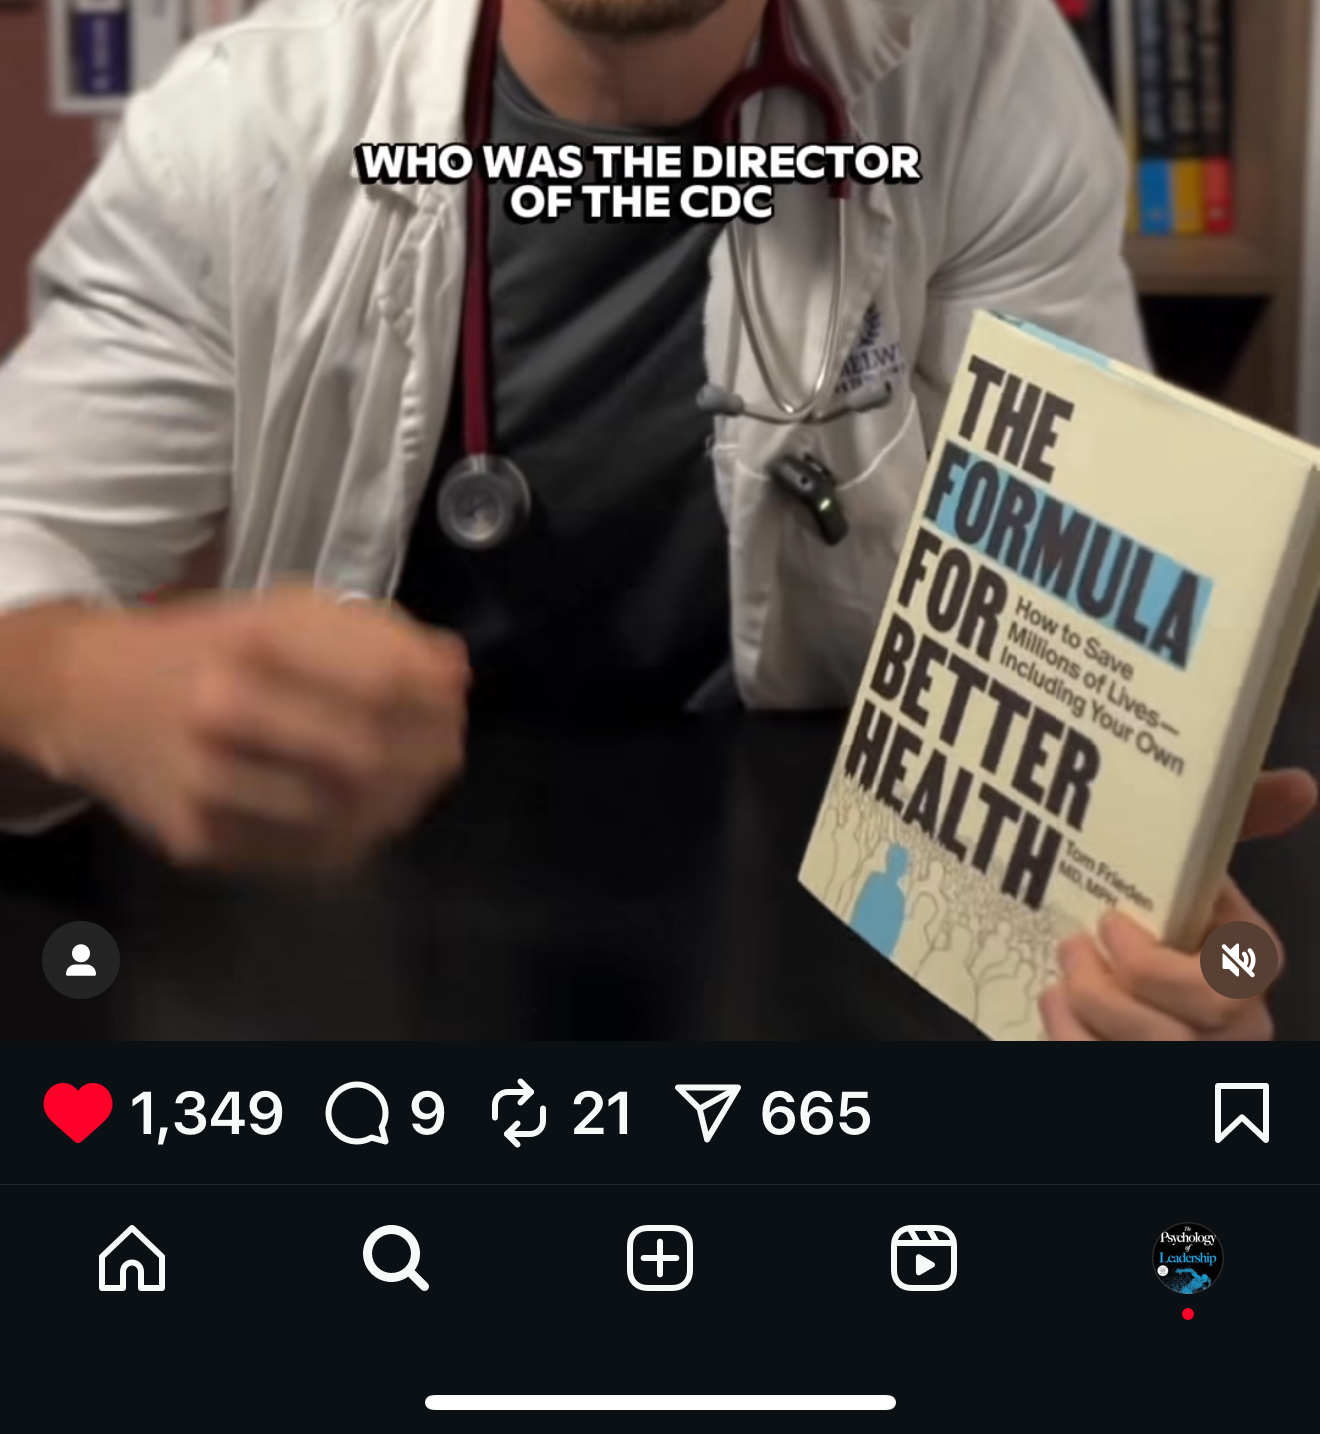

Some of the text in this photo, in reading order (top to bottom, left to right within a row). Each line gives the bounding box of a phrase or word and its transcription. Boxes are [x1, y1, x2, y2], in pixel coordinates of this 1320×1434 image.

[957, 354, 1075, 484] THE
[923, 439, 1199, 670] FORMULA
[897, 526, 1009, 662] FOR
[1007, 621, 1082, 681] Millions
[1083, 671, 1107, 695] of
[1015, 595, 1135, 681] How to Save
[869, 612, 1101, 833] BETTER
[1000, 645, 1186, 777] Including Your Own
[844, 698, 1063, 911] HEALTH
[1066, 839, 1154, 913] Tom Frieden
[132, 1090, 283, 1145] 1,349
[411, 1090, 445, 1136] 9
[573, 1090, 628, 1135] 21
[762, 1090, 871, 1136] 665
[1159, 1251, 1218, 1266] Leadership
[1160, 1231, 1217, 1246] Psychology
